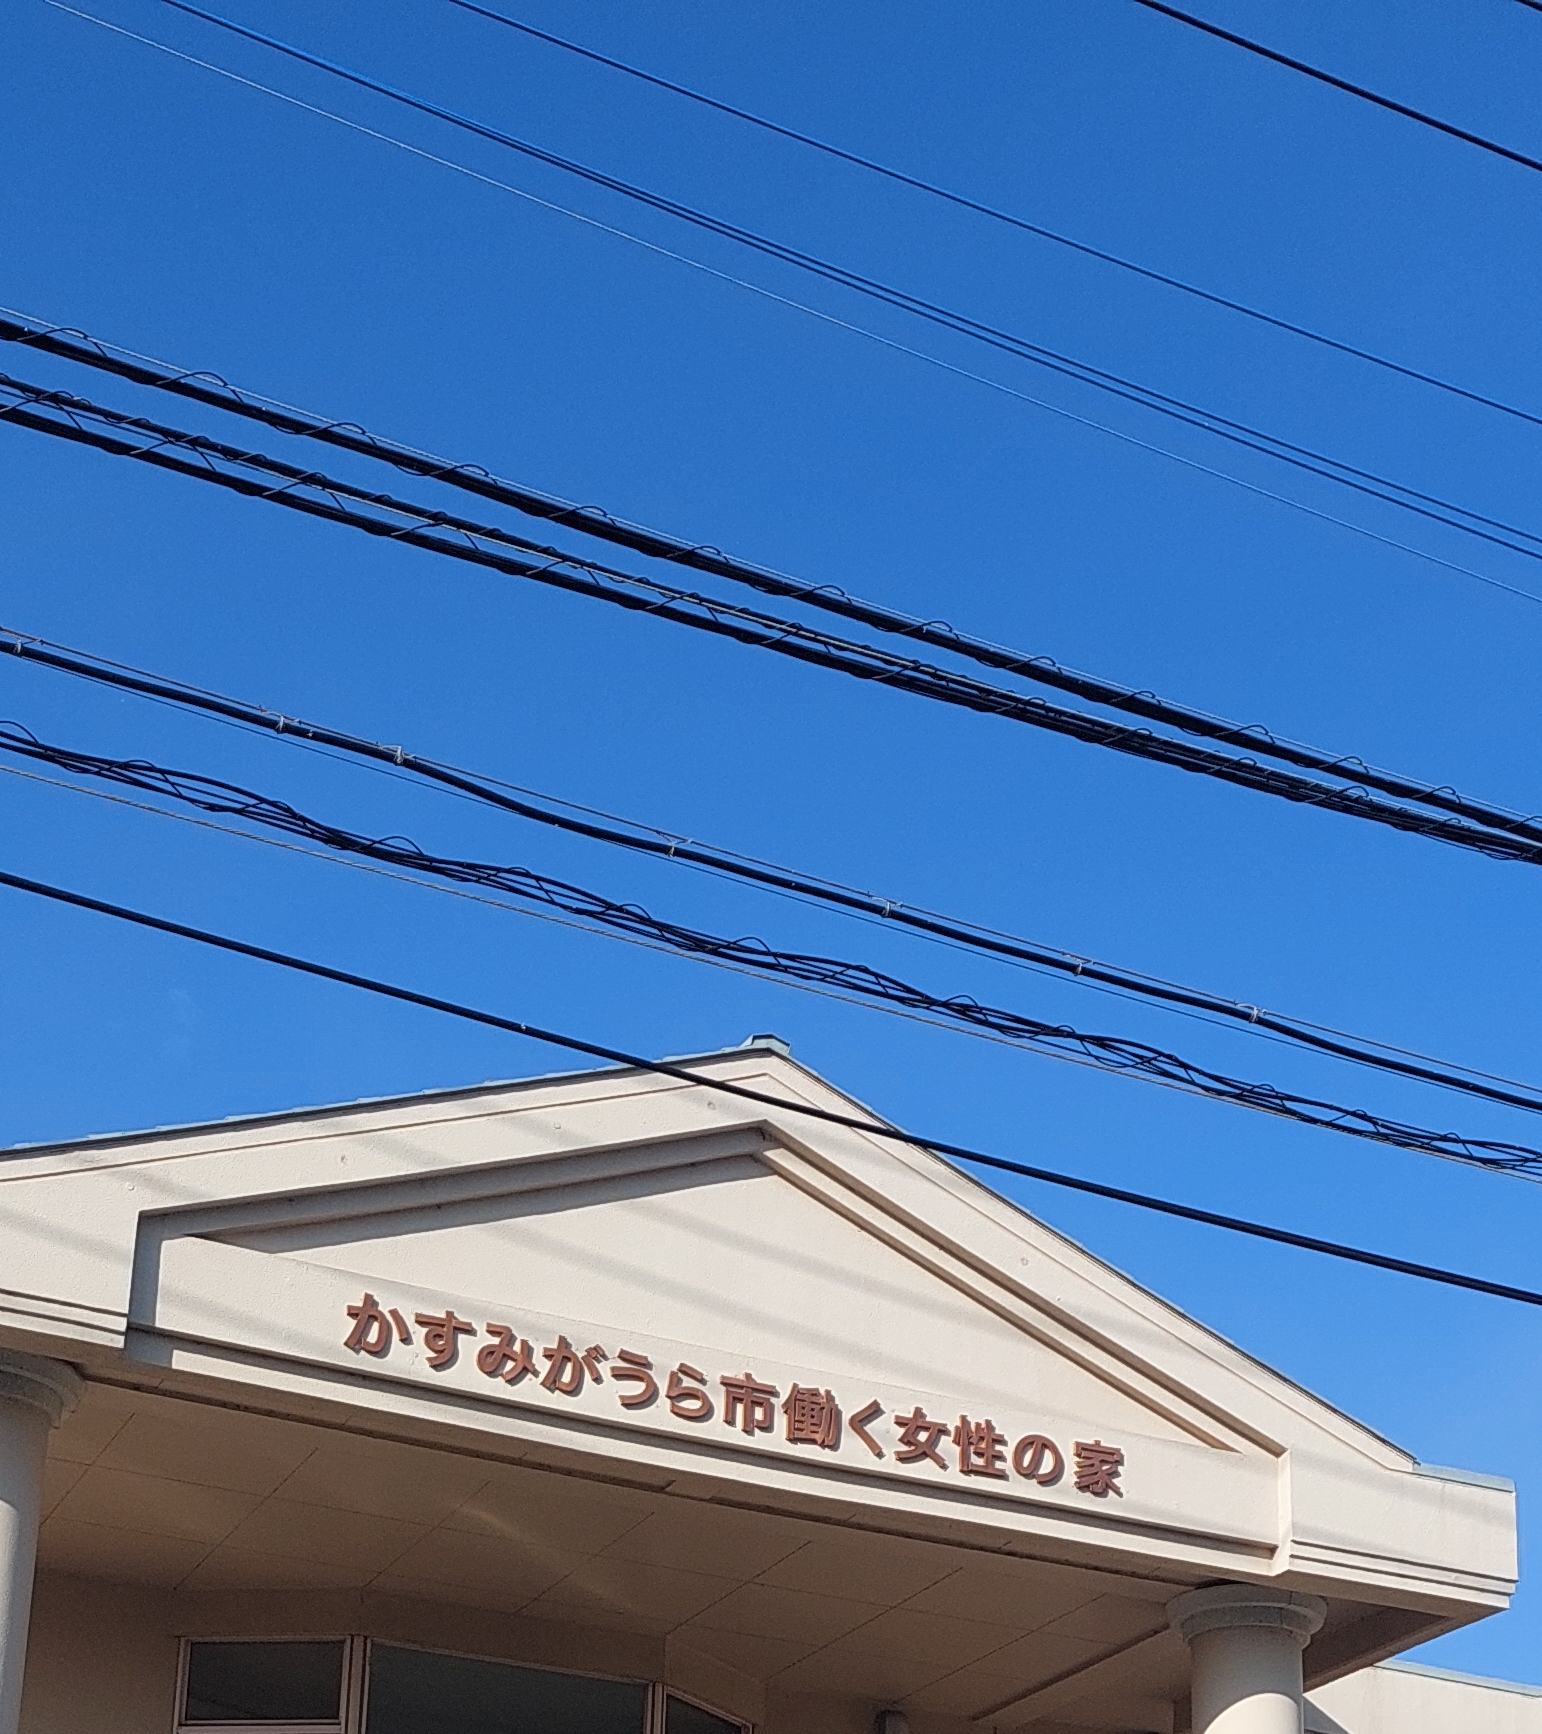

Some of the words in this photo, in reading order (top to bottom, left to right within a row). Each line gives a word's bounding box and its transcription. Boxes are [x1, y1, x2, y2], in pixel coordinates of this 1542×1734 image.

[343, 1292, 1125, 1498] かすみがうら市働く女性の家
